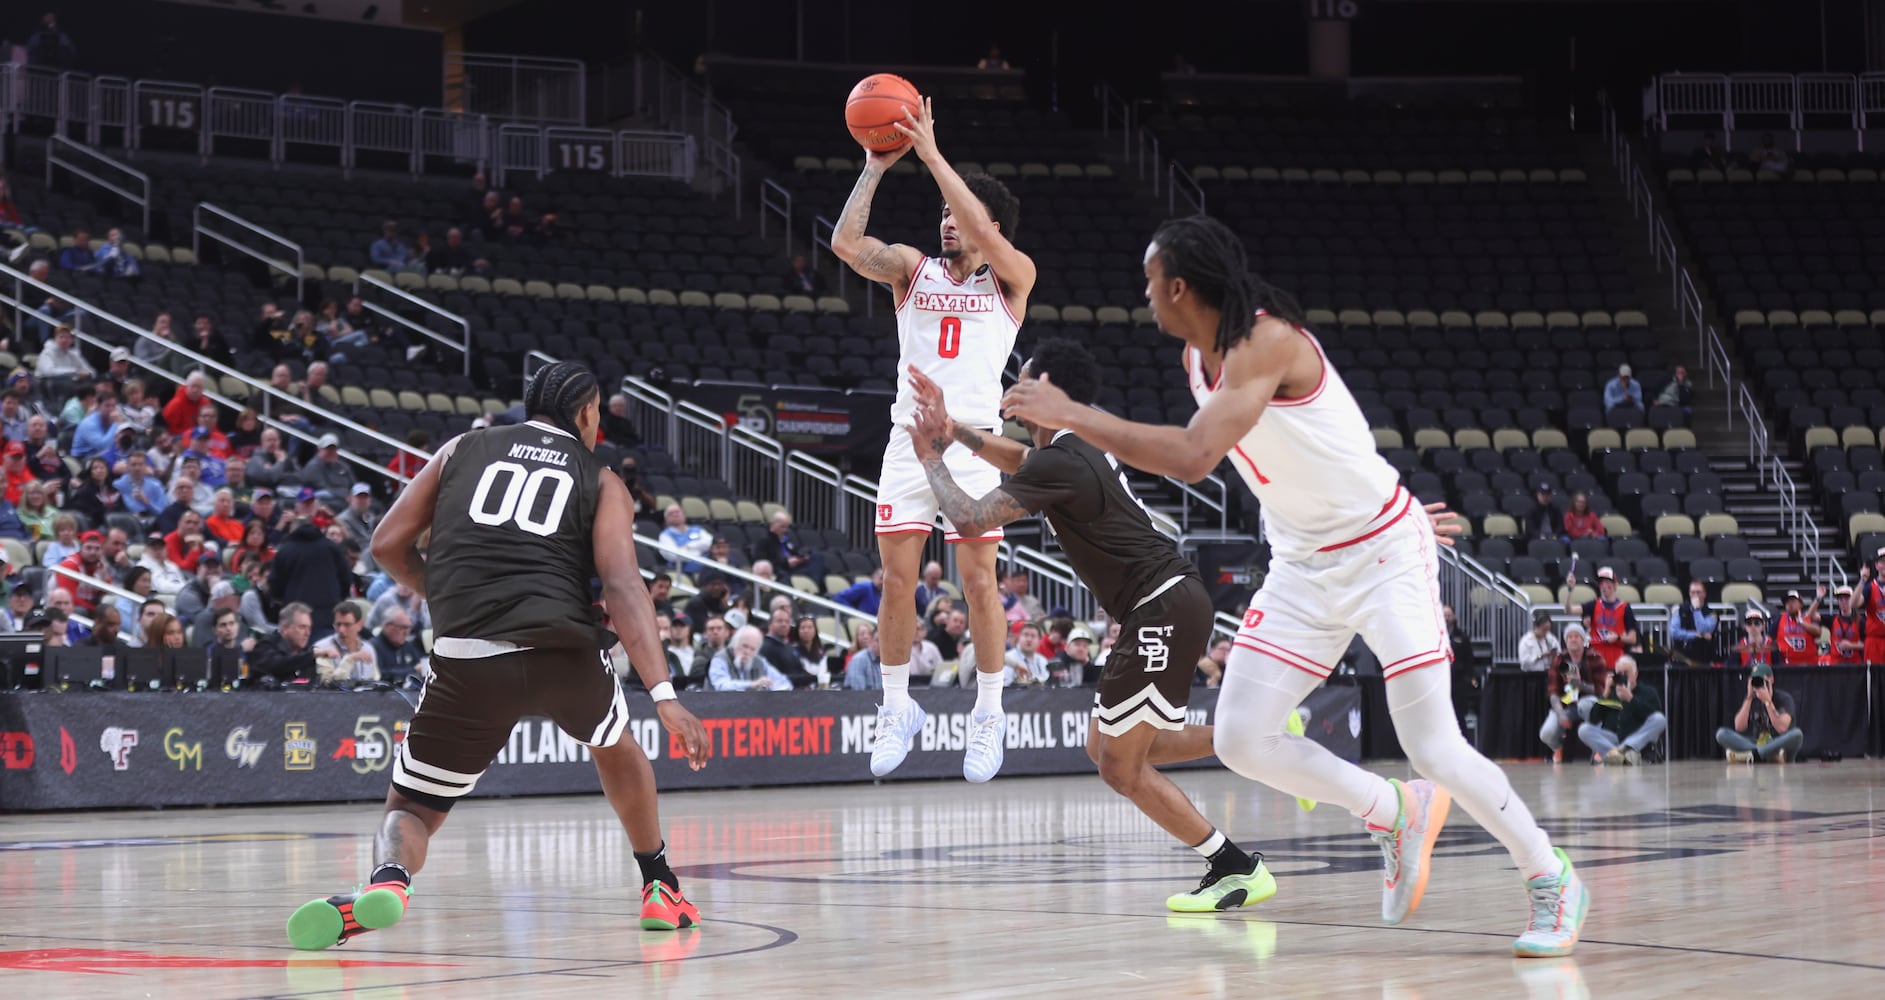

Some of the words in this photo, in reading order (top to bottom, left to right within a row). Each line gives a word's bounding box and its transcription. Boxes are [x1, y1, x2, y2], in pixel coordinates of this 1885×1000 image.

[149, 98, 195, 129] 115
[560, 143, 605, 170] 115
[914, 291, 994, 313] DAYTON
[938, 316, 961, 359] 0
[508, 443, 569, 466] MITCHELL
[468, 460, 575, 537] 00
[164, 727, 202, 771] GM
[224, 725, 268, 769] GW
[920, 711, 1057, 752] BASBALL
